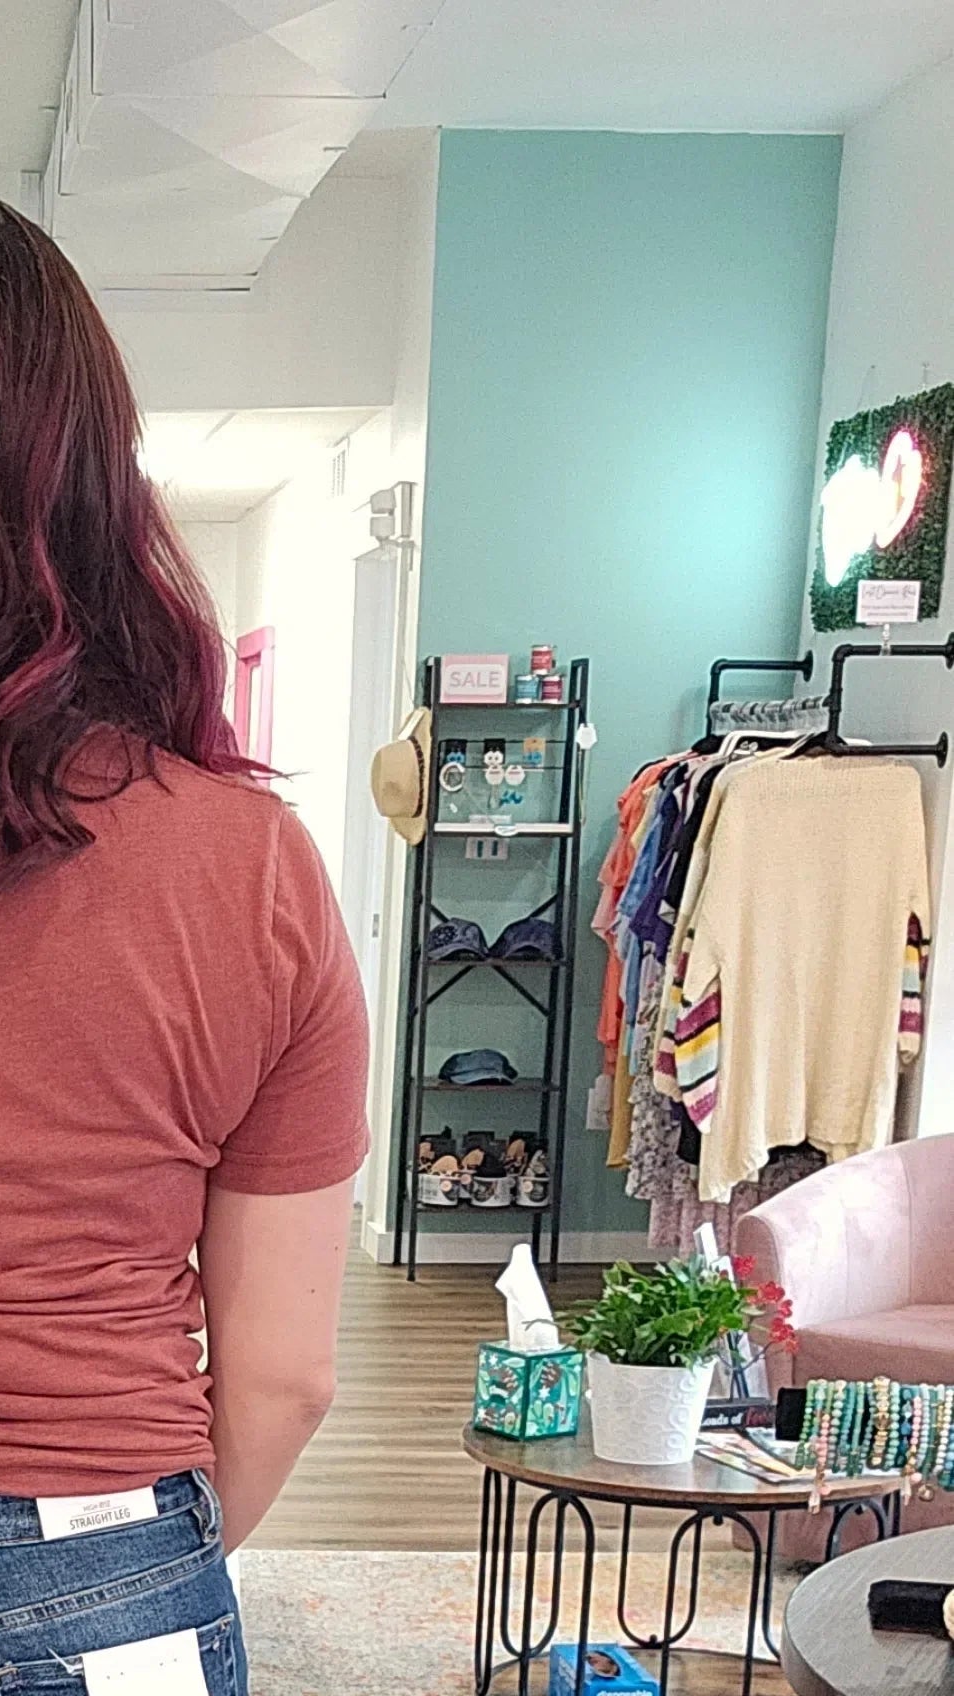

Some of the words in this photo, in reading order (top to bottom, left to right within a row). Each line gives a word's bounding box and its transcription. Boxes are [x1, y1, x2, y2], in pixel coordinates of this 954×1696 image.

[449, 671, 501, 689] SALE
[730, 1412, 744, 1425] of
[69, 1511, 113, 1531] STRAIGHT
[114, 1507, 131, 1520] LEG
